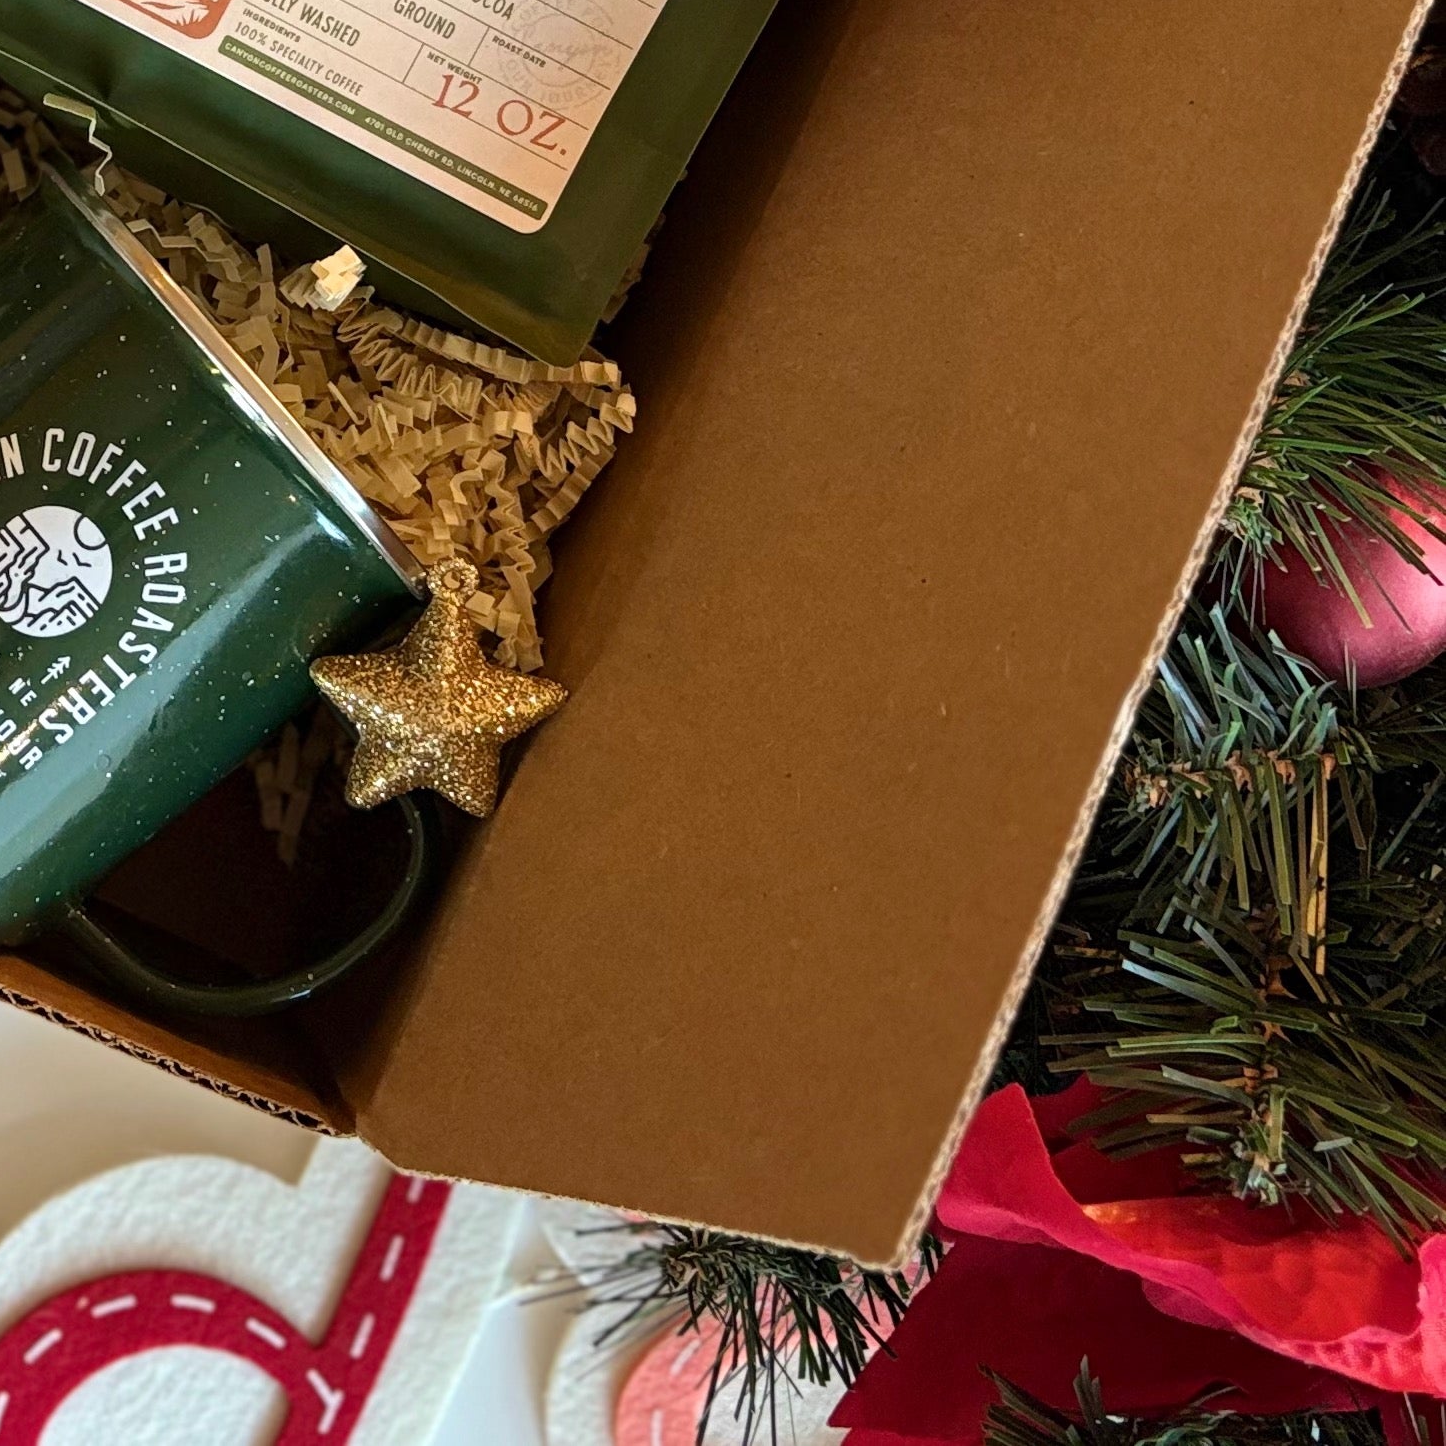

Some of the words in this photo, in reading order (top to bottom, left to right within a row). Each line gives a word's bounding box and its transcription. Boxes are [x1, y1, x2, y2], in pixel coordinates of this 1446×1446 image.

[242, 8, 301, 43] INGREDIENTS
[299, 3, 361, 47] WASHED
[492, 35, 524, 55] ROAST
[522, 51, 547, 68] DATE
[234, 21, 268, 46] 100%
[269, 39, 325, 75] SPECIALTY
[324, 69, 364, 97] COFFEE
[427, 51, 446, 66] NET
[447, 62, 483, 86] WEIGHT
[433, 73, 480, 119] 12
[497, 103, 569, 156] OZ.
[385, 127, 404, 141] OLD
[499, 186, 512, 198] NE
[41, 427, 180, 541] COFFEE
[38, 552, 188, 744] ROASTERS
[8, 677, 38, 707] NE
